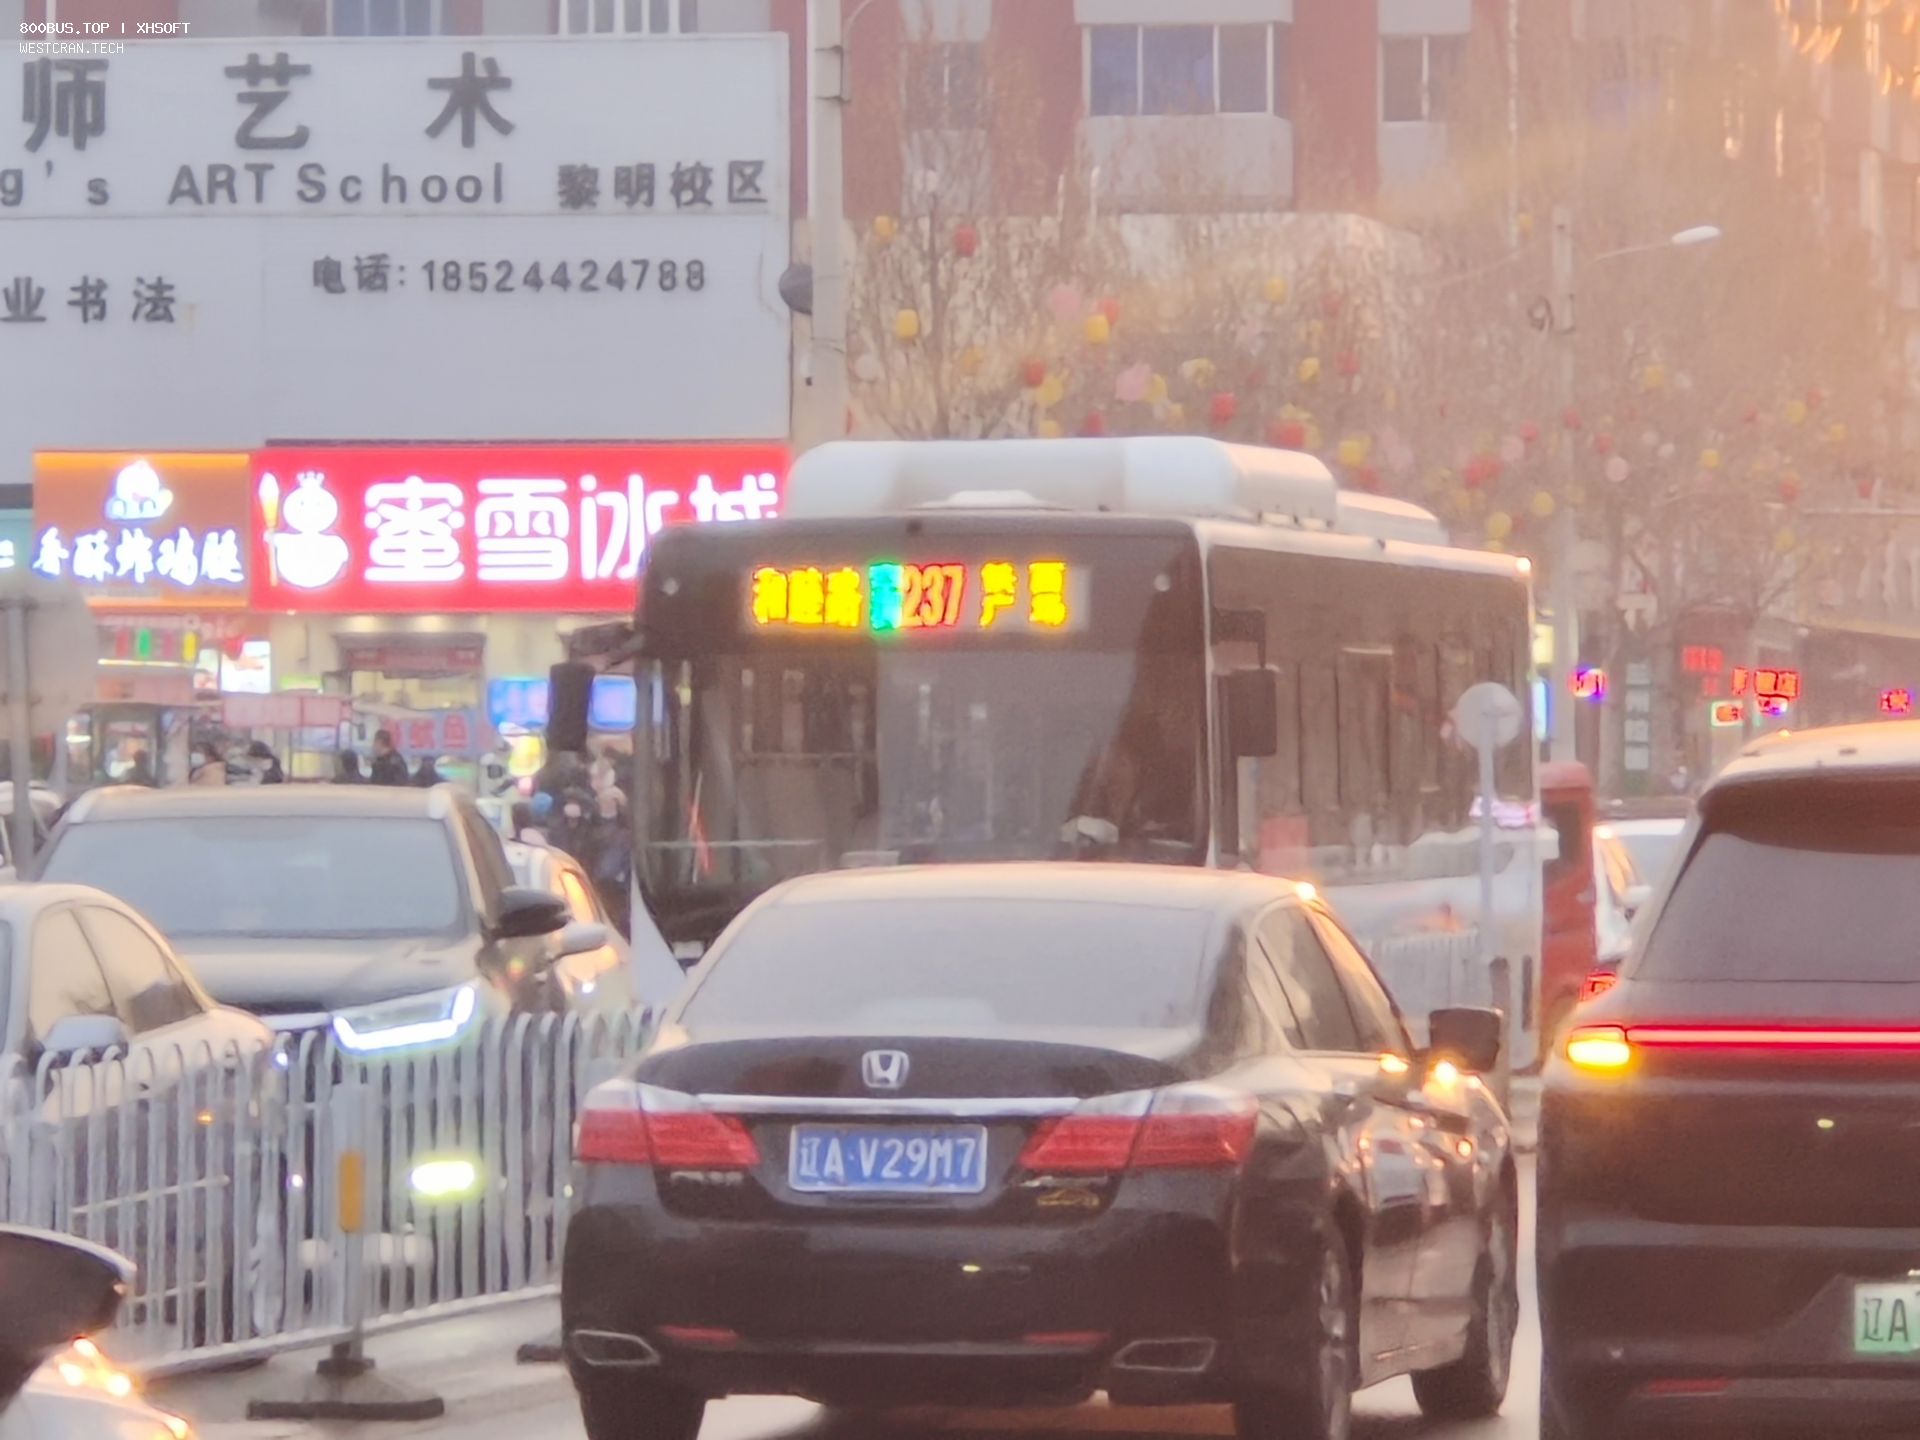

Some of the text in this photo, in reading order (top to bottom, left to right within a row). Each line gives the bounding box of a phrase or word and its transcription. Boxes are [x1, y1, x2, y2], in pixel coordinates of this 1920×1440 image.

[22, 52, 515, 153] 师艺术
[167, 163, 276, 206] ART
[296, 162, 503, 205] School
[557, 160, 768, 210] 黎明校区
[0, 275, 176, 324] 业书法
[901, 563, 964, 628] 237
